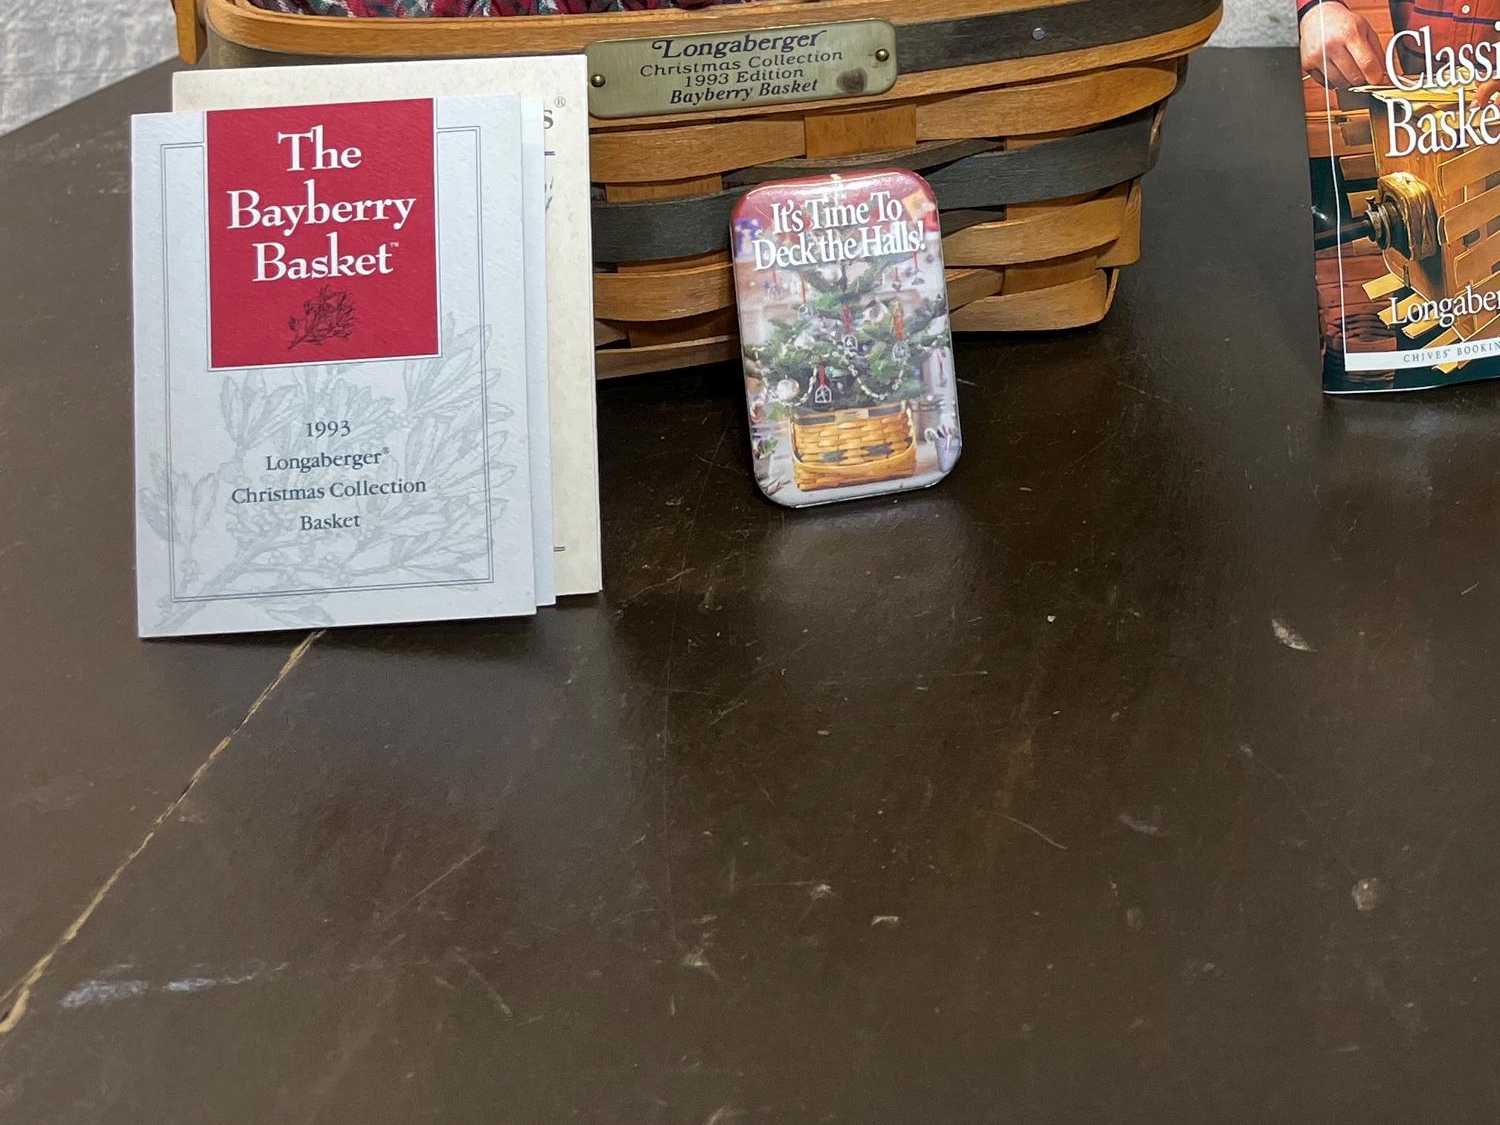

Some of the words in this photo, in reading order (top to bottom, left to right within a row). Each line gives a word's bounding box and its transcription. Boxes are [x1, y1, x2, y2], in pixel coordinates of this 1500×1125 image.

[652, 29, 828, 59] Longaberger
[640, 59, 741, 77] Christmas
[748, 50, 844, 69] Collection
[683, 72, 730, 88] 1993
[736, 66, 805, 85] Edition
[670, 84, 754, 106] Bayberry
[758, 77, 819, 97] Basket
[277, 124, 362, 171] The
[226, 180, 416, 237] Bayberry
[771, 201, 803, 236] It's
[808, 195, 870, 228] Time
[869, 190, 904, 222] To
[752, 230, 820, 271] Deck
[820, 232, 857, 262] the
[858, 220, 928, 258] Halls!
[305, 418, 352, 439] 1993
[231, 481, 326, 505] Christmas
[329, 476, 427, 500] Collection
[299, 511, 361, 532] Basket
